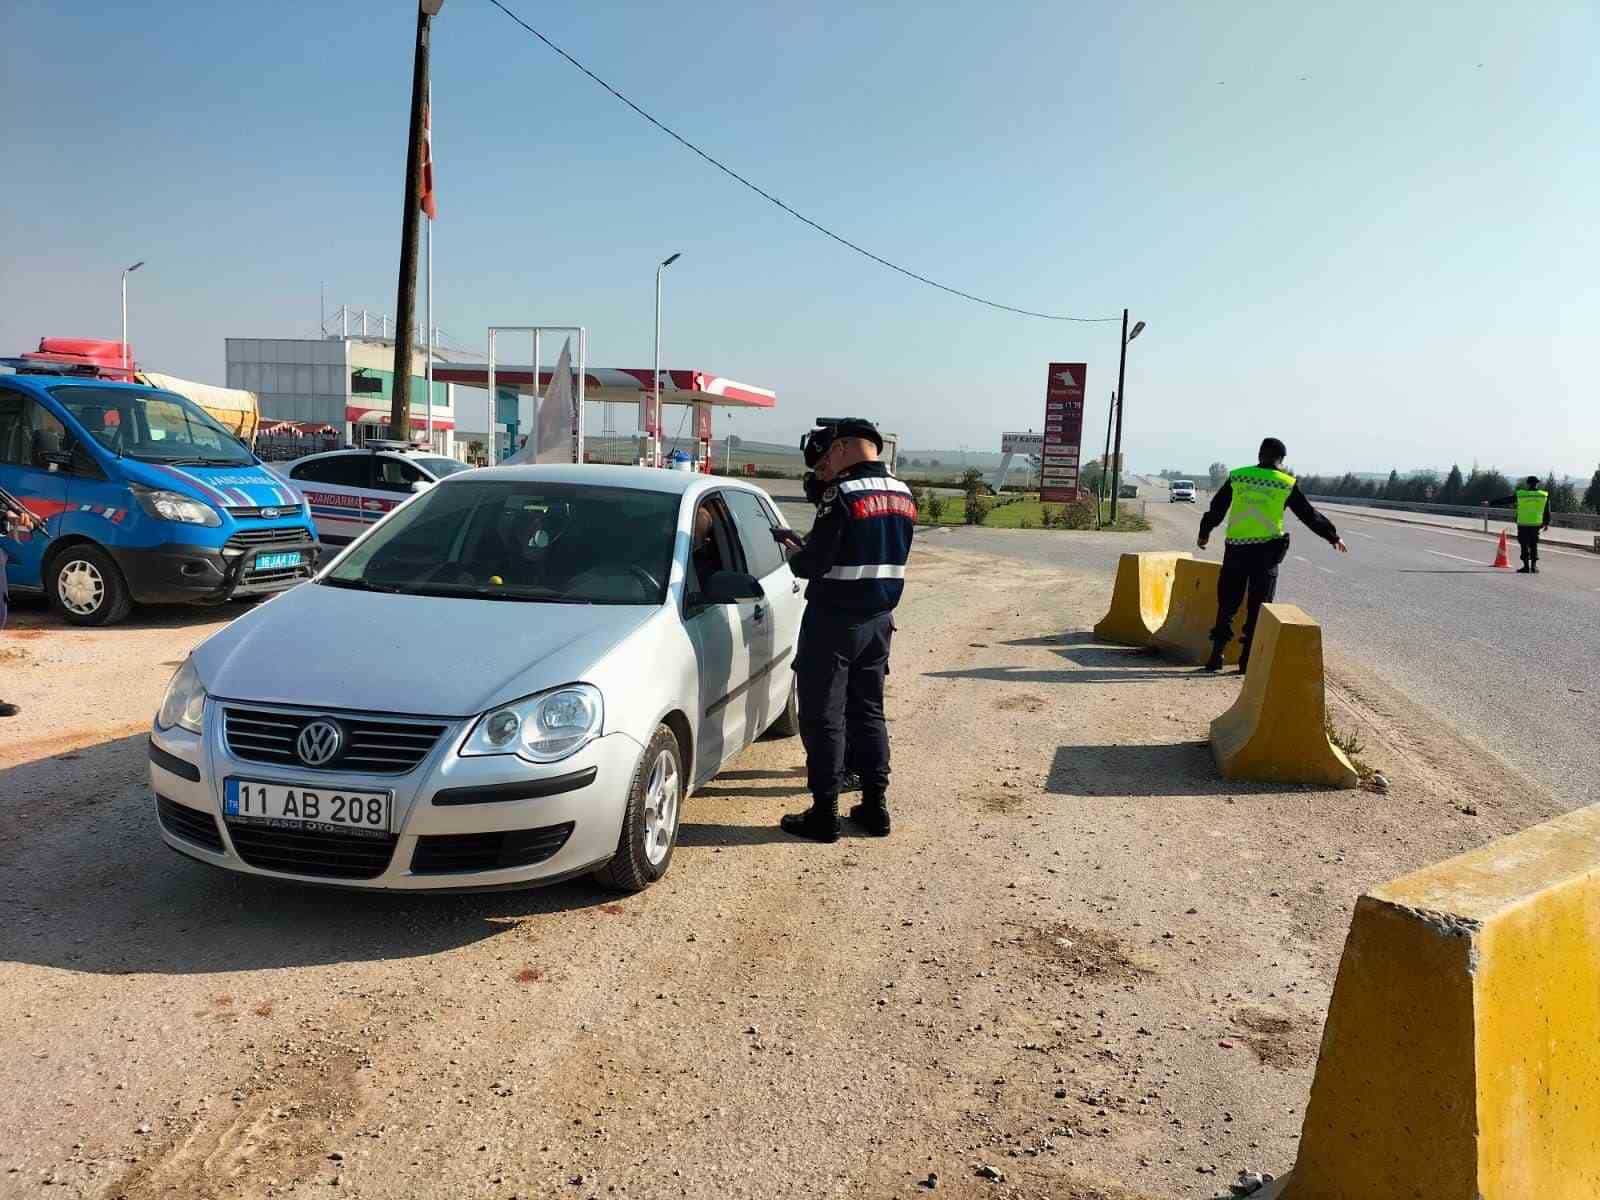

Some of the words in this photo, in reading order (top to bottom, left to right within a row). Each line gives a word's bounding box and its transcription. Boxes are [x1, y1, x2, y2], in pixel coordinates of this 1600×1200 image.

[312, 493, 362, 507] JANDARMA
[241, 785, 267, 815] 11
[282, 790, 320, 819] AB
[330, 795, 382, 825] 208
